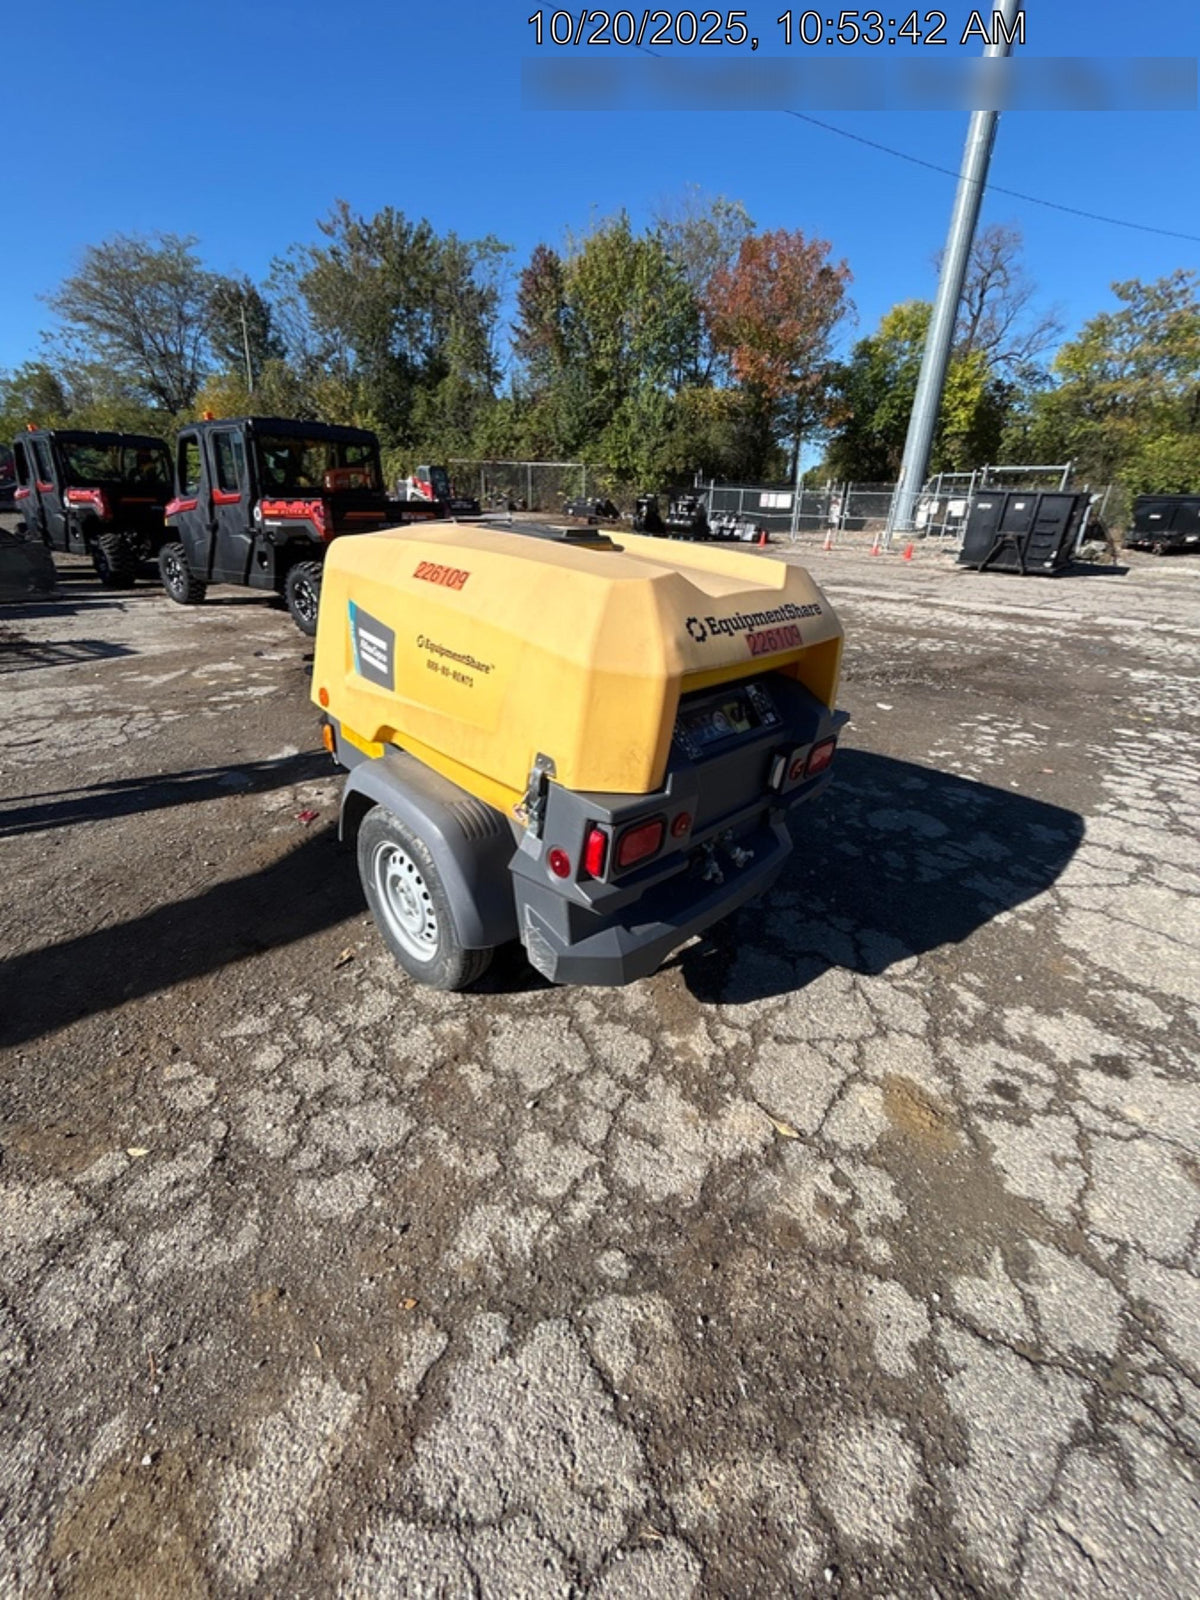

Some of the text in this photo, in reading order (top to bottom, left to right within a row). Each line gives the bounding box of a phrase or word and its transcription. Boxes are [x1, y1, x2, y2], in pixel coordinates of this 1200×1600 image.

[412, 560, 470, 591] 226109
[704, 603, 822, 637] EquipmentShare
[745, 624, 803, 657] 226109
